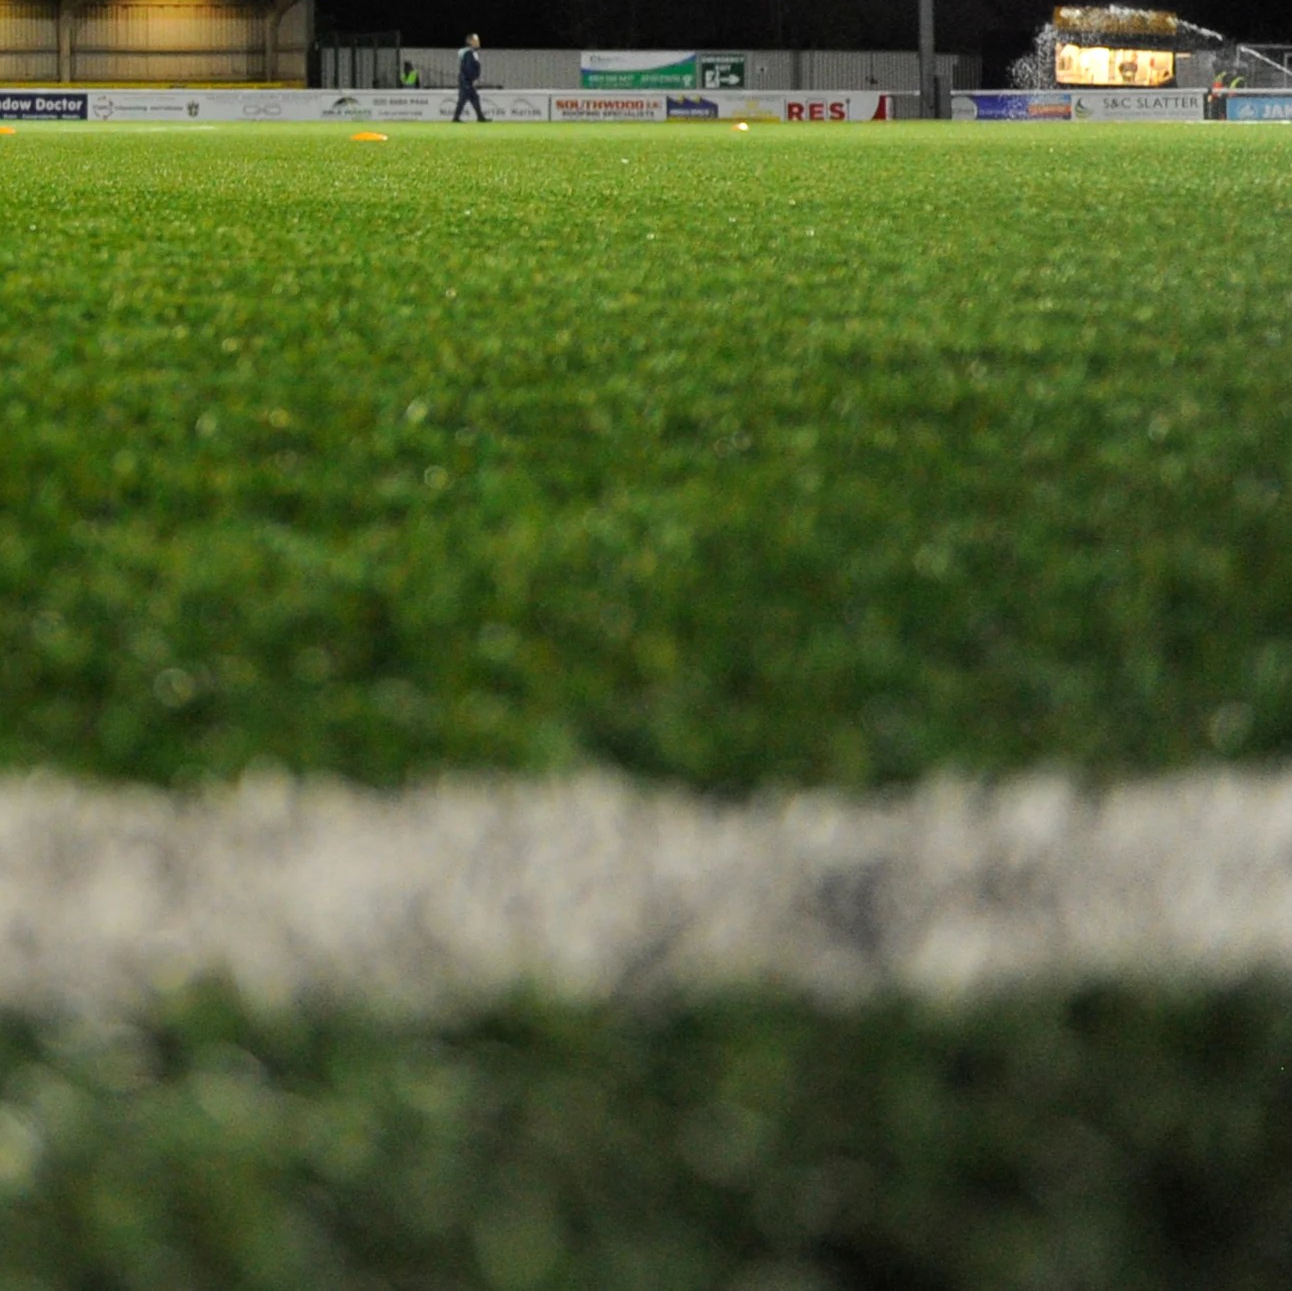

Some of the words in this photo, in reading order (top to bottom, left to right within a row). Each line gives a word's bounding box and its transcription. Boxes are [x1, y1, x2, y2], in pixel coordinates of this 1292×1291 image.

[35, 97, 82, 111] Doctor
[1103, 97, 1132, 109] S&C
[1136, 97, 1199, 109] SLATTER
[787, 102, 847, 120] RES
